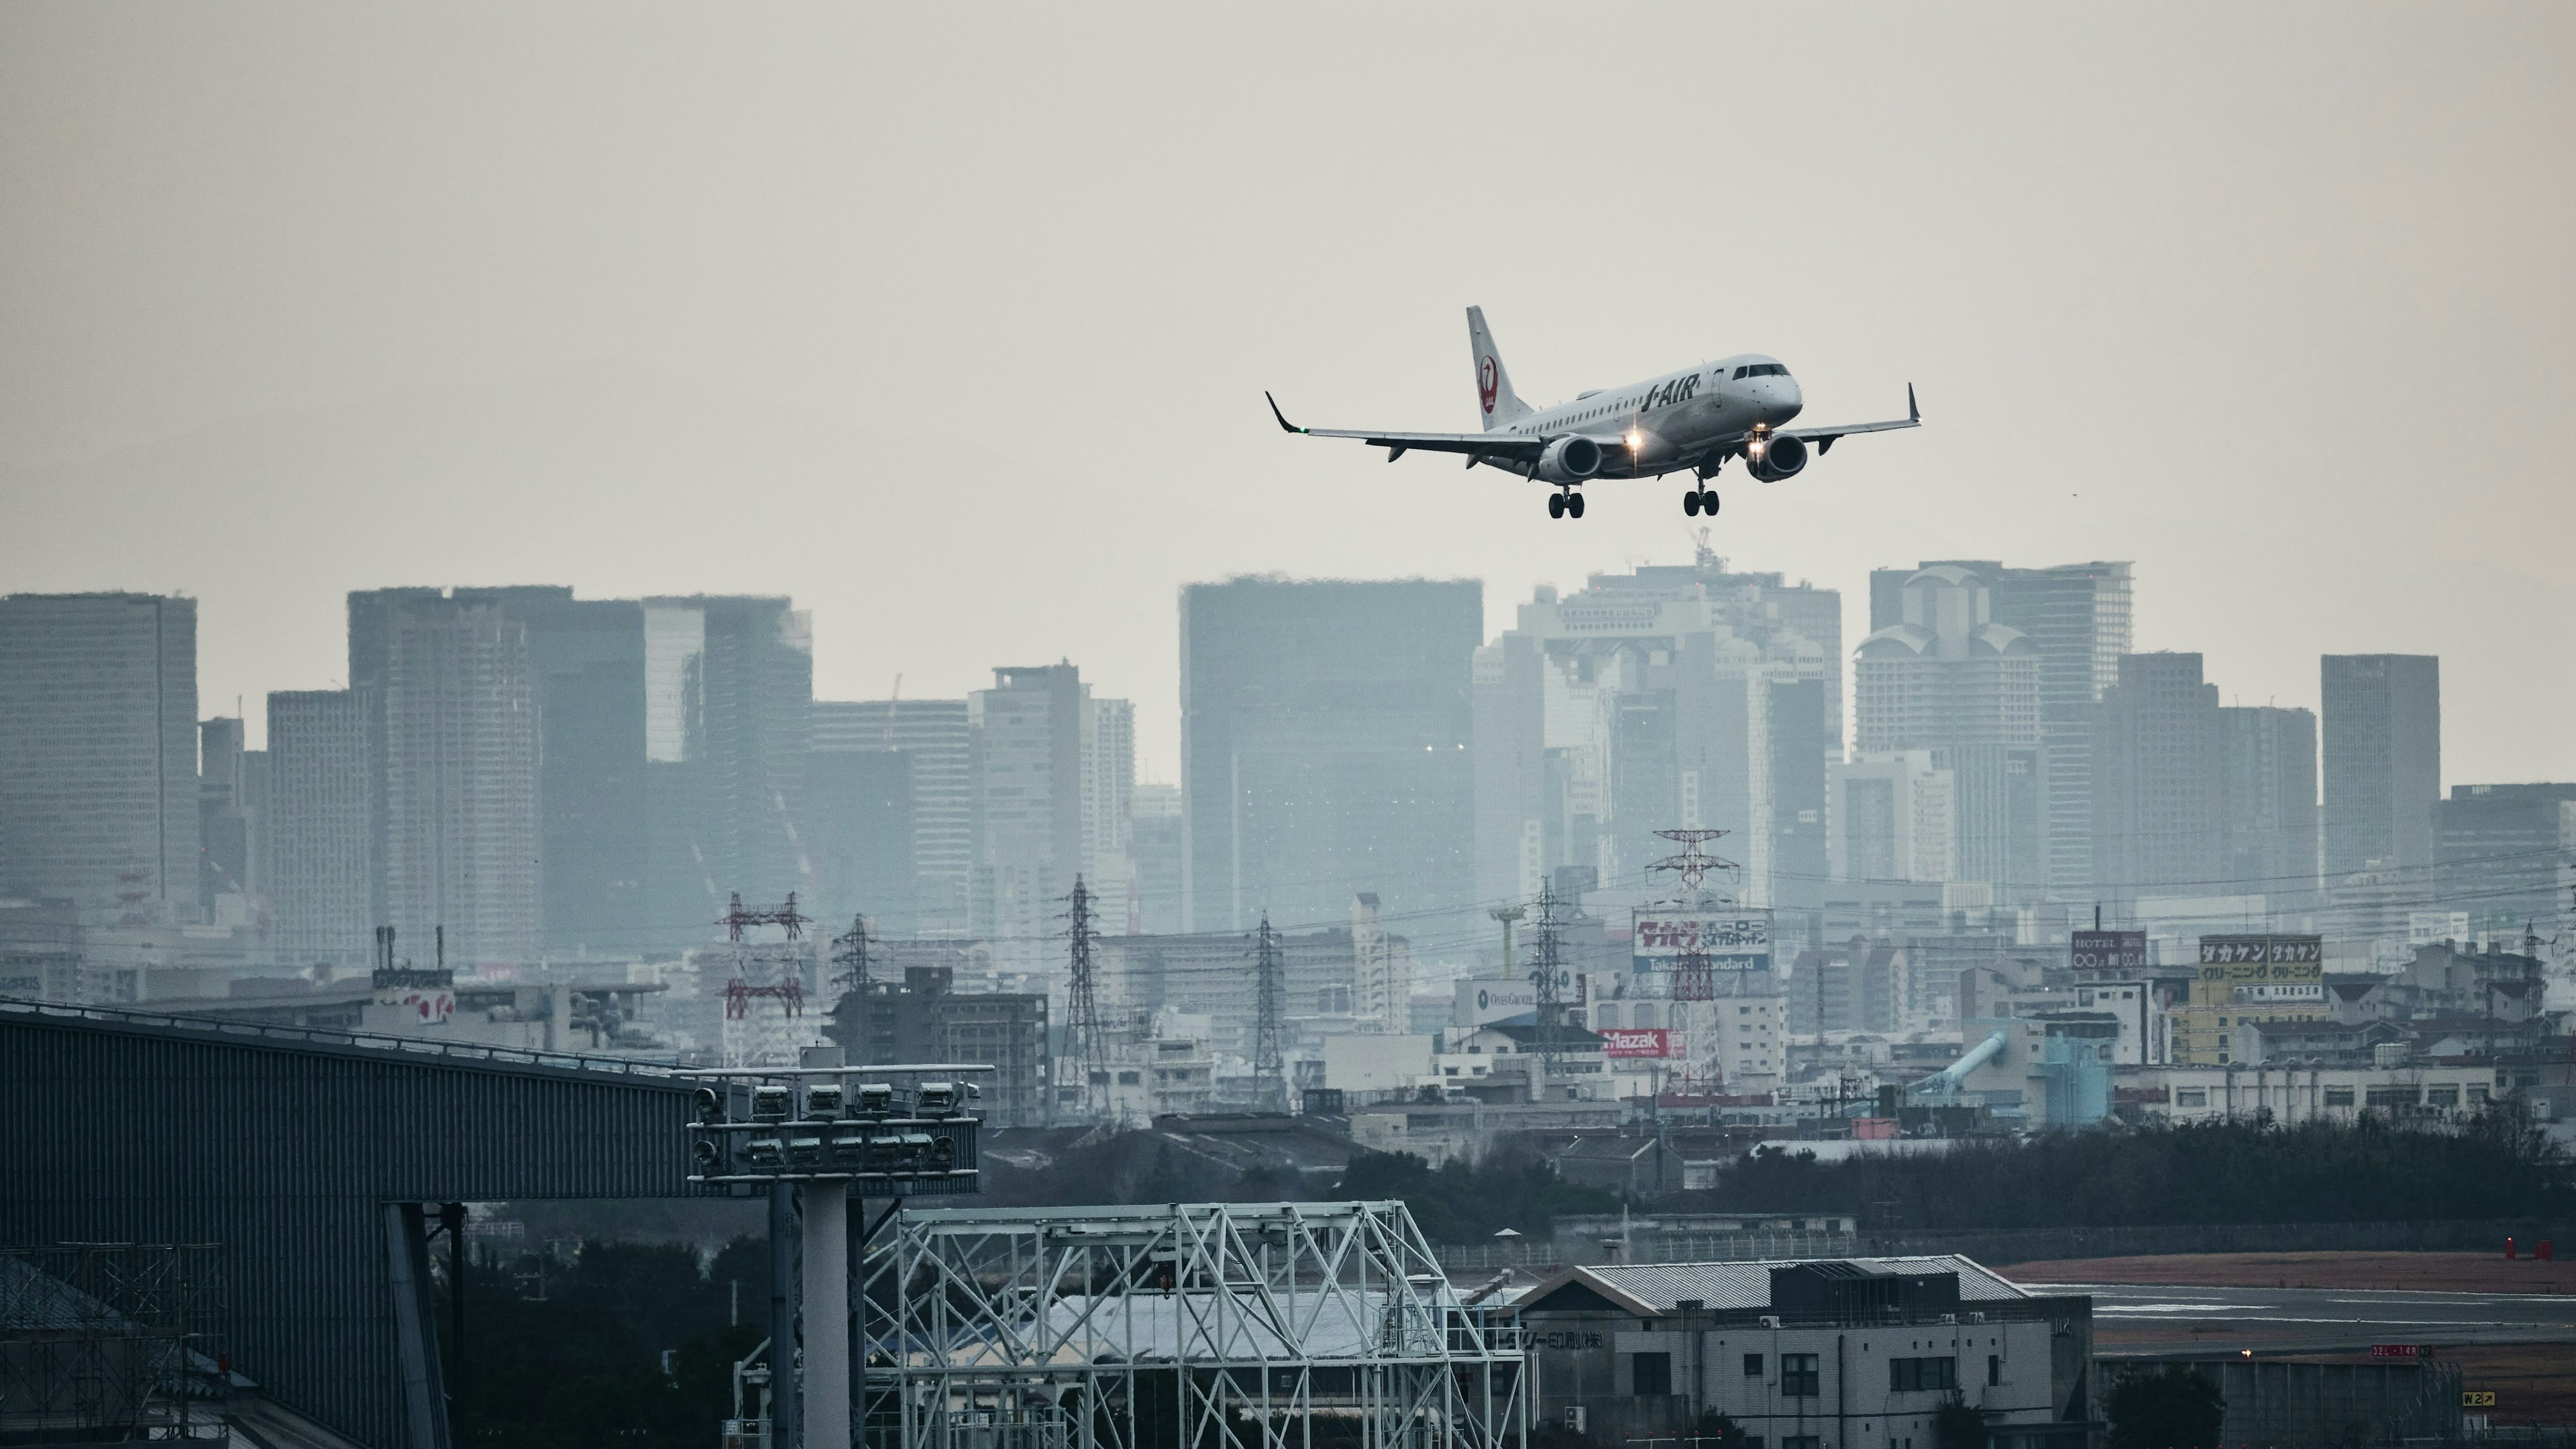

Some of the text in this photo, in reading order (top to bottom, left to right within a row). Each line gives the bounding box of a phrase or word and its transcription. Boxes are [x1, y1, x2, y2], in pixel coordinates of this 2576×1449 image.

[1641, 373, 1700, 413] J-AIR
[2076, 939, 2116, 948] HOTEL
[2202, 944, 2266, 963] タカケン
[2272, 943, 2319, 961] タカケン
[2203, 965, 2267, 979] クリーニング
[2273, 964, 2320, 979] クリーニング
[1603, 1032, 1659, 1049] Mazak
[2464, 1394, 2481, 1404] W2
